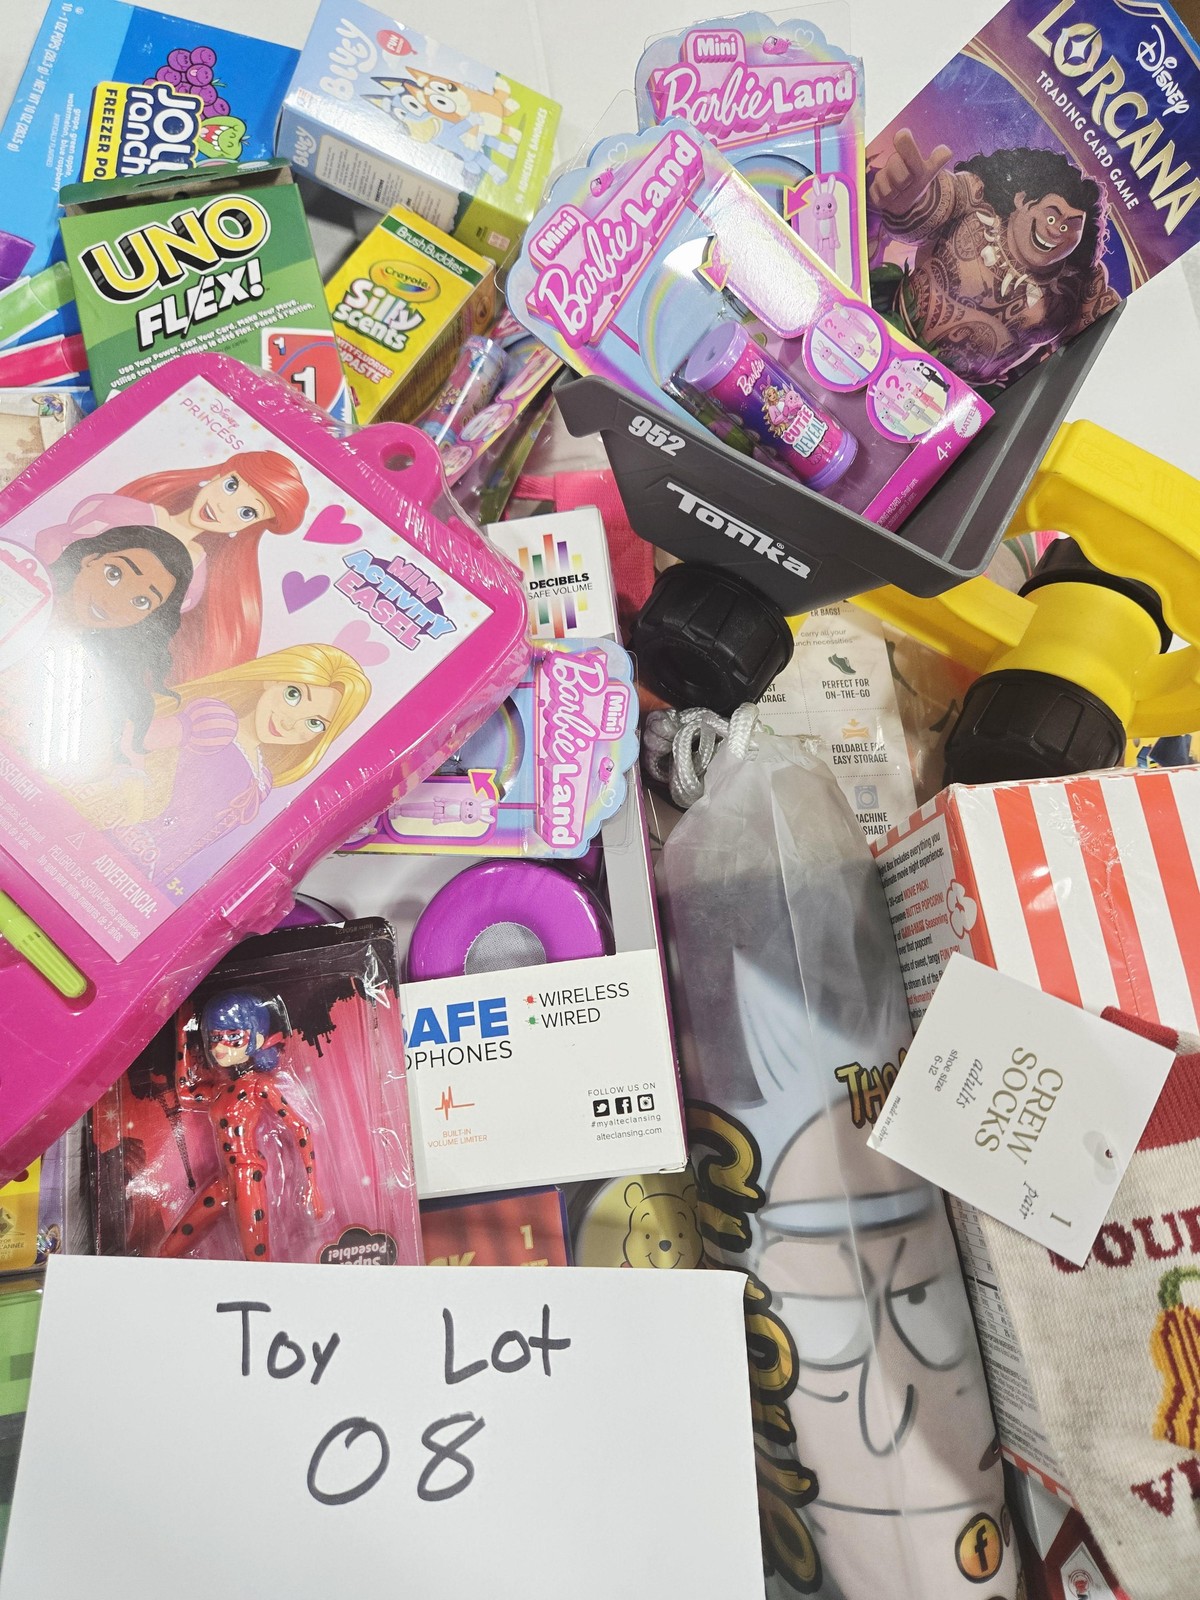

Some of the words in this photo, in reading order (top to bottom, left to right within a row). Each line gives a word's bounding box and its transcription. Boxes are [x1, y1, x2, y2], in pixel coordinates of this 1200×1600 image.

[48, 31, 64, 51] POPS
[696, 35, 737, 57] Mini
[28, 93, 41, 106] WT
[32, 78, 47, 95] NET
[663, 66, 772, 128] Barbie
[771, 70, 854, 114] Land
[97, 88, 118, 153] FREEZER
[1027, 0, 1200, 236] LORCANA
[59, 139, 68, 156] blue
[69, 133, 78, 154] green
[121, 91, 154, 178] ranch
[1035, 70, 1087, 132] TRADING
[1083, 129, 1114, 167] CARD
[1109, 168, 1140, 211] GAME
[51, 156, 65, 193] raspberry
[626, 135, 698, 228] Land
[537, 213, 577, 254] Mini
[80, 195, 270, 304] UNO
[383, 267, 430, 290] Crayola
[538, 221, 640, 337] Barbie
[136, 257, 264, 351] FLEX!
[345, 277, 425, 332] Silly
[110, 373, 137, 389] Utilise
[235, 326, 255, 338] Flex.
[254, 316, 278, 329] Passe
[118, 364, 134, 375] Use
[134, 359, 152, 368] Your
[152, 347, 180, 361] Power.
[180, 339, 197, 351] Flex
[197, 332, 215, 345] Your
[215, 323, 237, 335] Card.
[237, 314, 258, 328] Make
[257, 307, 275, 318] Your
[275, 299, 300, 312] Move.
[273, 336, 286, 356] 1
[180, 397, 245, 451] PRINCESS
[628, 415, 686, 458] 952
[783, 406, 813, 444] CUTIE
[793, 419, 827, 457] REVEAL
[958, 407, 979, 438] MATTEL
[936, 439, 953, 462] 4+
[666, 481, 811, 580] Tonka
[343, 550, 457, 639] ACTIVITY
[387, 556, 443, 602] MINI
[528, 590, 551, 600] SAFE
[553, 582, 593, 596] VOLUME
[529, 572, 590, 591] DECIBELS
[334, 569, 421, 651] EASEL
[820, 607, 841, 616] BAGS!
[800, 630, 819, 638] carry
[820, 629, 830, 637] all
[831, 629, 847, 638] your
[822, 679, 853, 689] PERFECT
[855, 678, 870, 687] FOR
[825, 689, 871, 700] ON-THE-GO
[552, 656, 605, 764] Barbie
[605, 694, 625, 734] Mini
[831, 742, 869, 753] FOLDABLE
[833, 754, 852, 765] EASY
[853, 753, 889, 764] STORAGE
[552, 763, 578, 846] Land
[48, 845, 76, 873] PELIGRO
[92, 854, 158, 919] ADVERTENCIA:
[166, 877, 184, 896] 3+
[539, 982, 630, 1008] WIRELESS
[402, 997, 509, 1048] AFE
[541, 1007, 601, 1029] WIRED
[928, 1055, 943, 1076] 6-12
[943, 1049, 958, 1073] shoe
[588, 1086, 625, 1096] FOLLOW
[627, 1084, 639, 1092] US
[642, 1082, 656, 1091] ON
[934, 1072, 948, 1092] size
[956, 1058, 984, 1109] adults
[889, 1095, 901, 1116] made
[974, 1047, 1037, 1152] SOCKS
[591, 1114, 661, 1128] #myalteclansing
[1007, 1068, 1064, 1165] CREW
[428, 1137, 458, 1148] VOLUME
[460, 1134, 488, 1144] LIMITER
[443, 1128, 472, 1138] BUILT-IN
[596, 1127, 662, 1141] alteclansing.com
[1017, 1181, 1039, 1220] pair
[1050, 1212, 1072, 1228] 1
[328, 1241, 387, 1261] Poseable!
[519, 1224, 534, 1250] 1
[216, 1301, 341, 1385] Toy
[442, 1303, 571, 1385] Lot
[306, 1410, 486, 1506] 08
